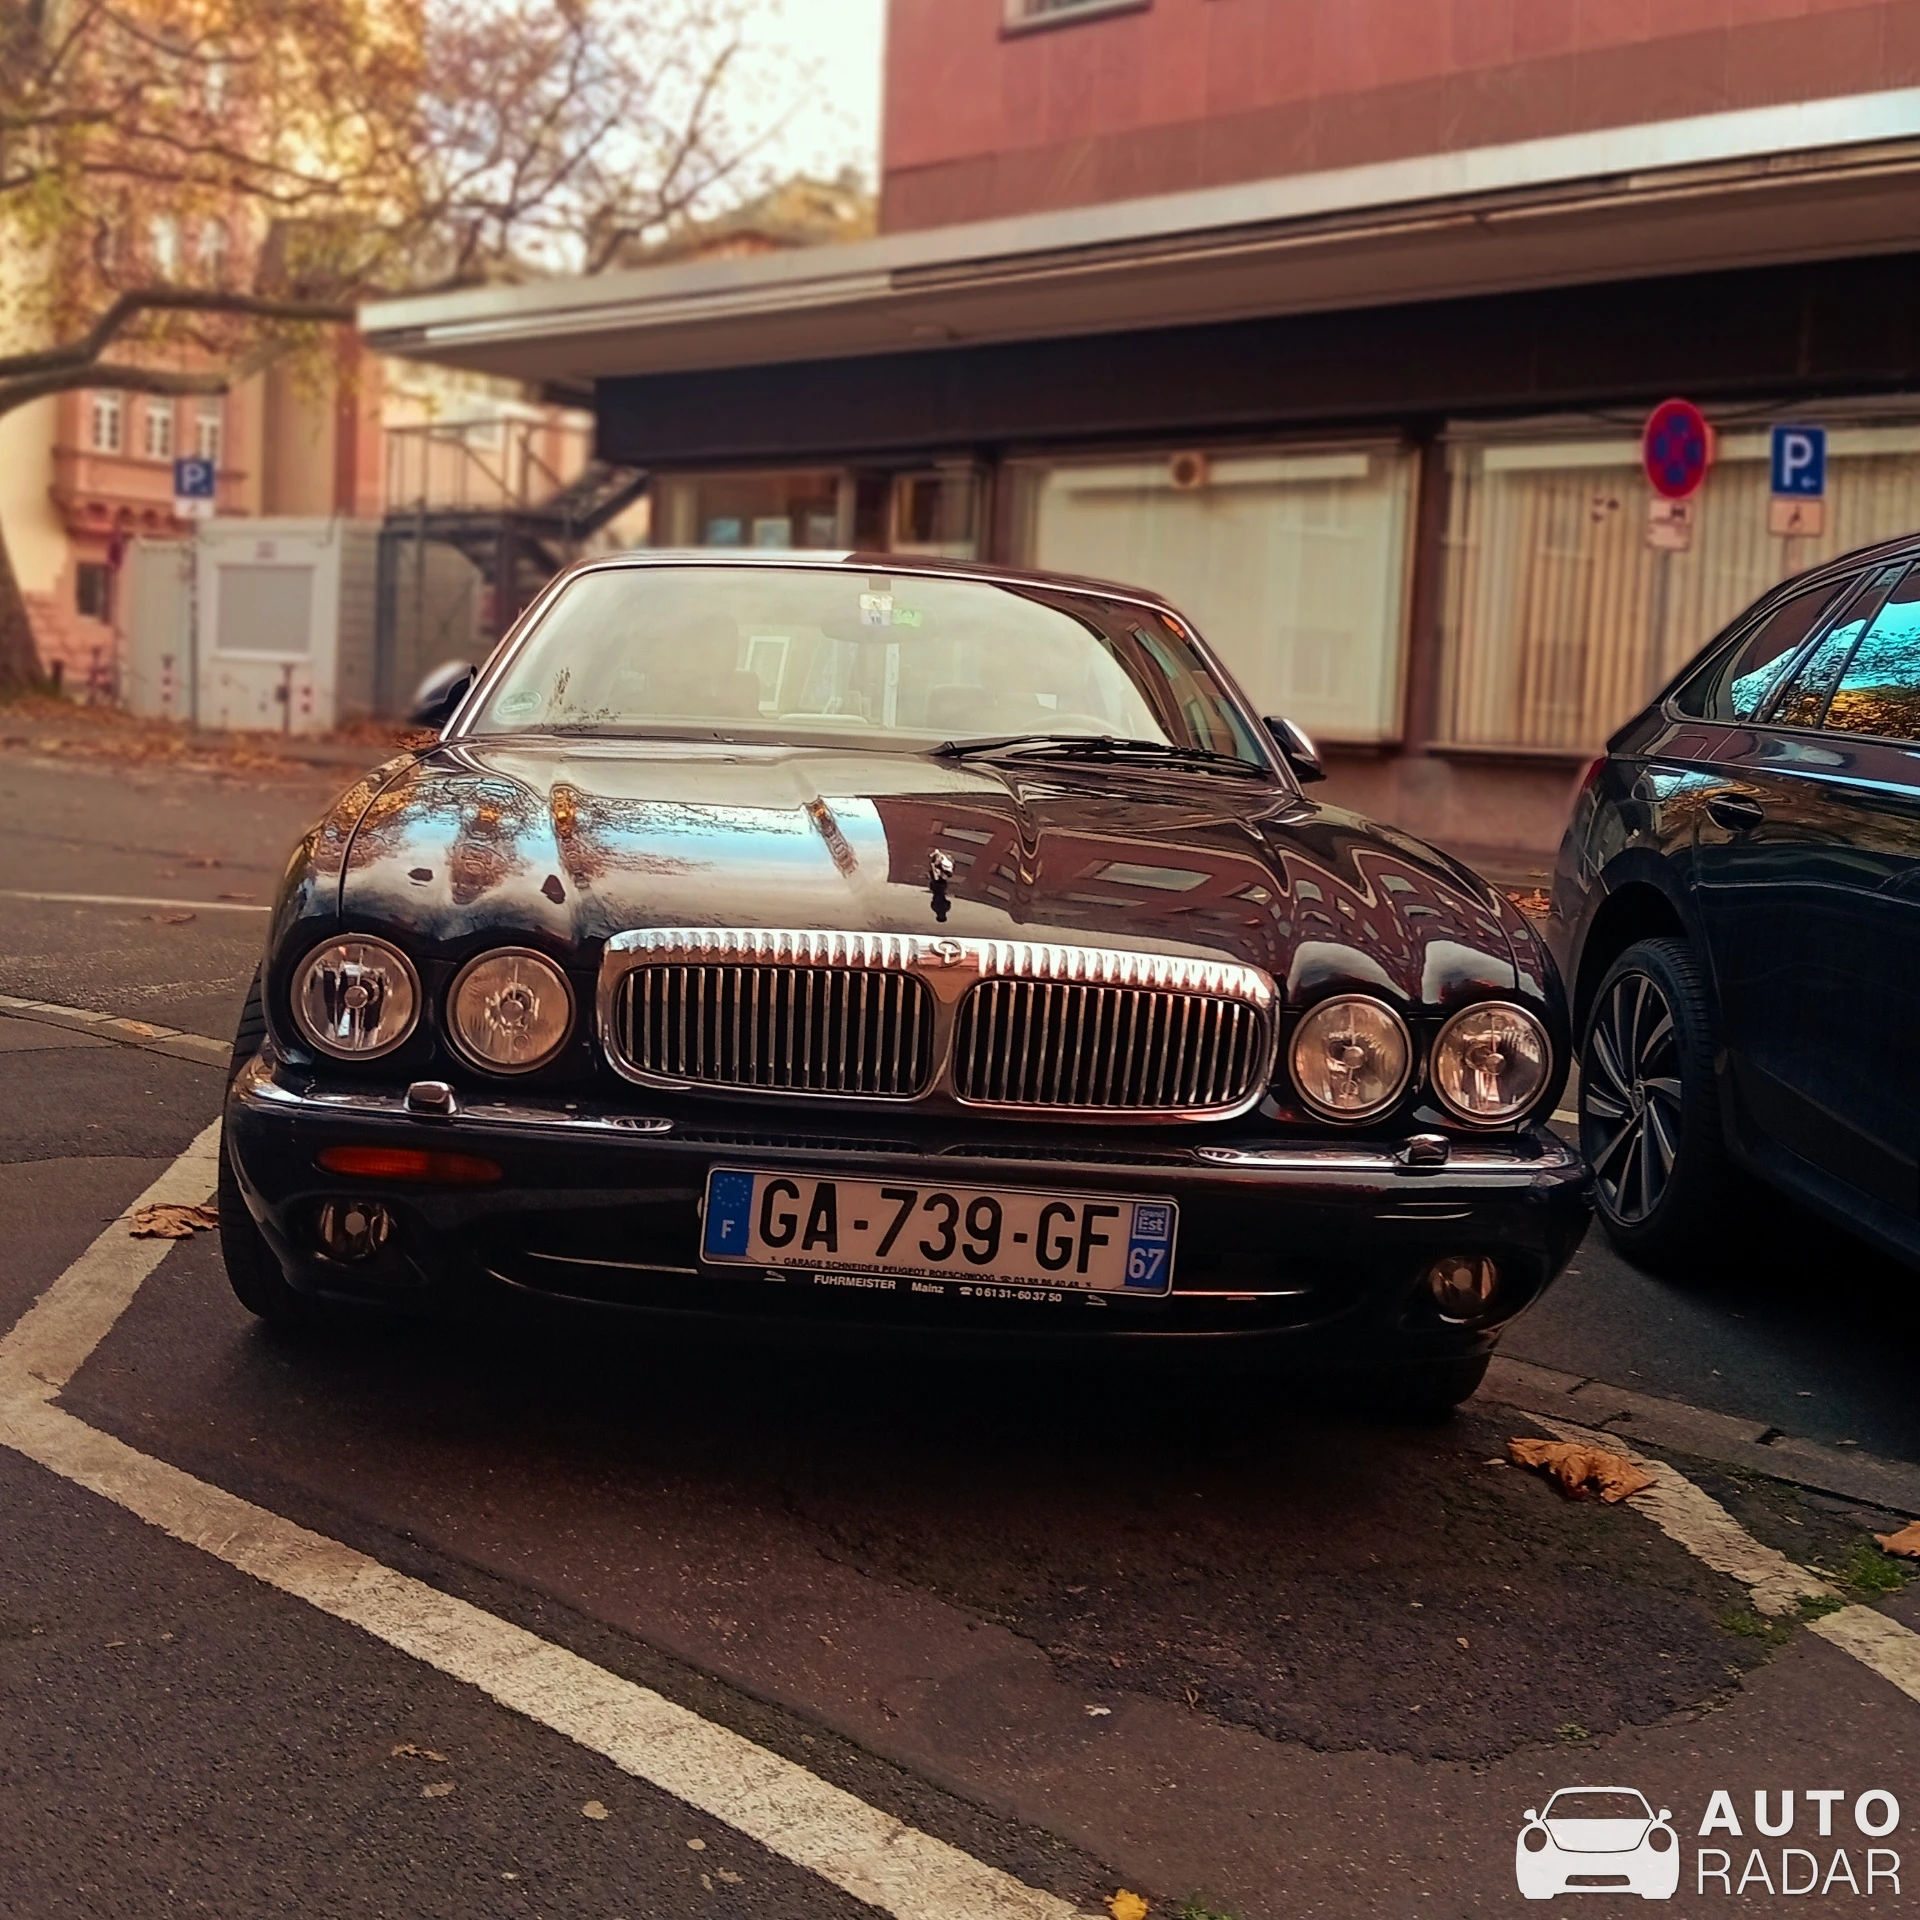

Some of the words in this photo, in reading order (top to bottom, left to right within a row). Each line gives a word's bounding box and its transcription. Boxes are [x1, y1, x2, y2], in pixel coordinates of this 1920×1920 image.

[1782, 433, 1813, 487] P
[183, 462, 206, 492] P
[721, 1219, 735, 1239] F
[759, 1178, 1120, 1274] GA-739-GF
[1137, 1216, 1164, 1231] Est
[783, 1257, 822, 1269] GARAGE
[825, 1260, 880, 1273] SCHNEIDER
[882, 1265, 926, 1277] PEUGEOT
[1128, 1247, 1165, 1279] 67
[813, 1274, 896, 1290] FUHRMEISTER
[911, 1282, 944, 1293] Mainz
